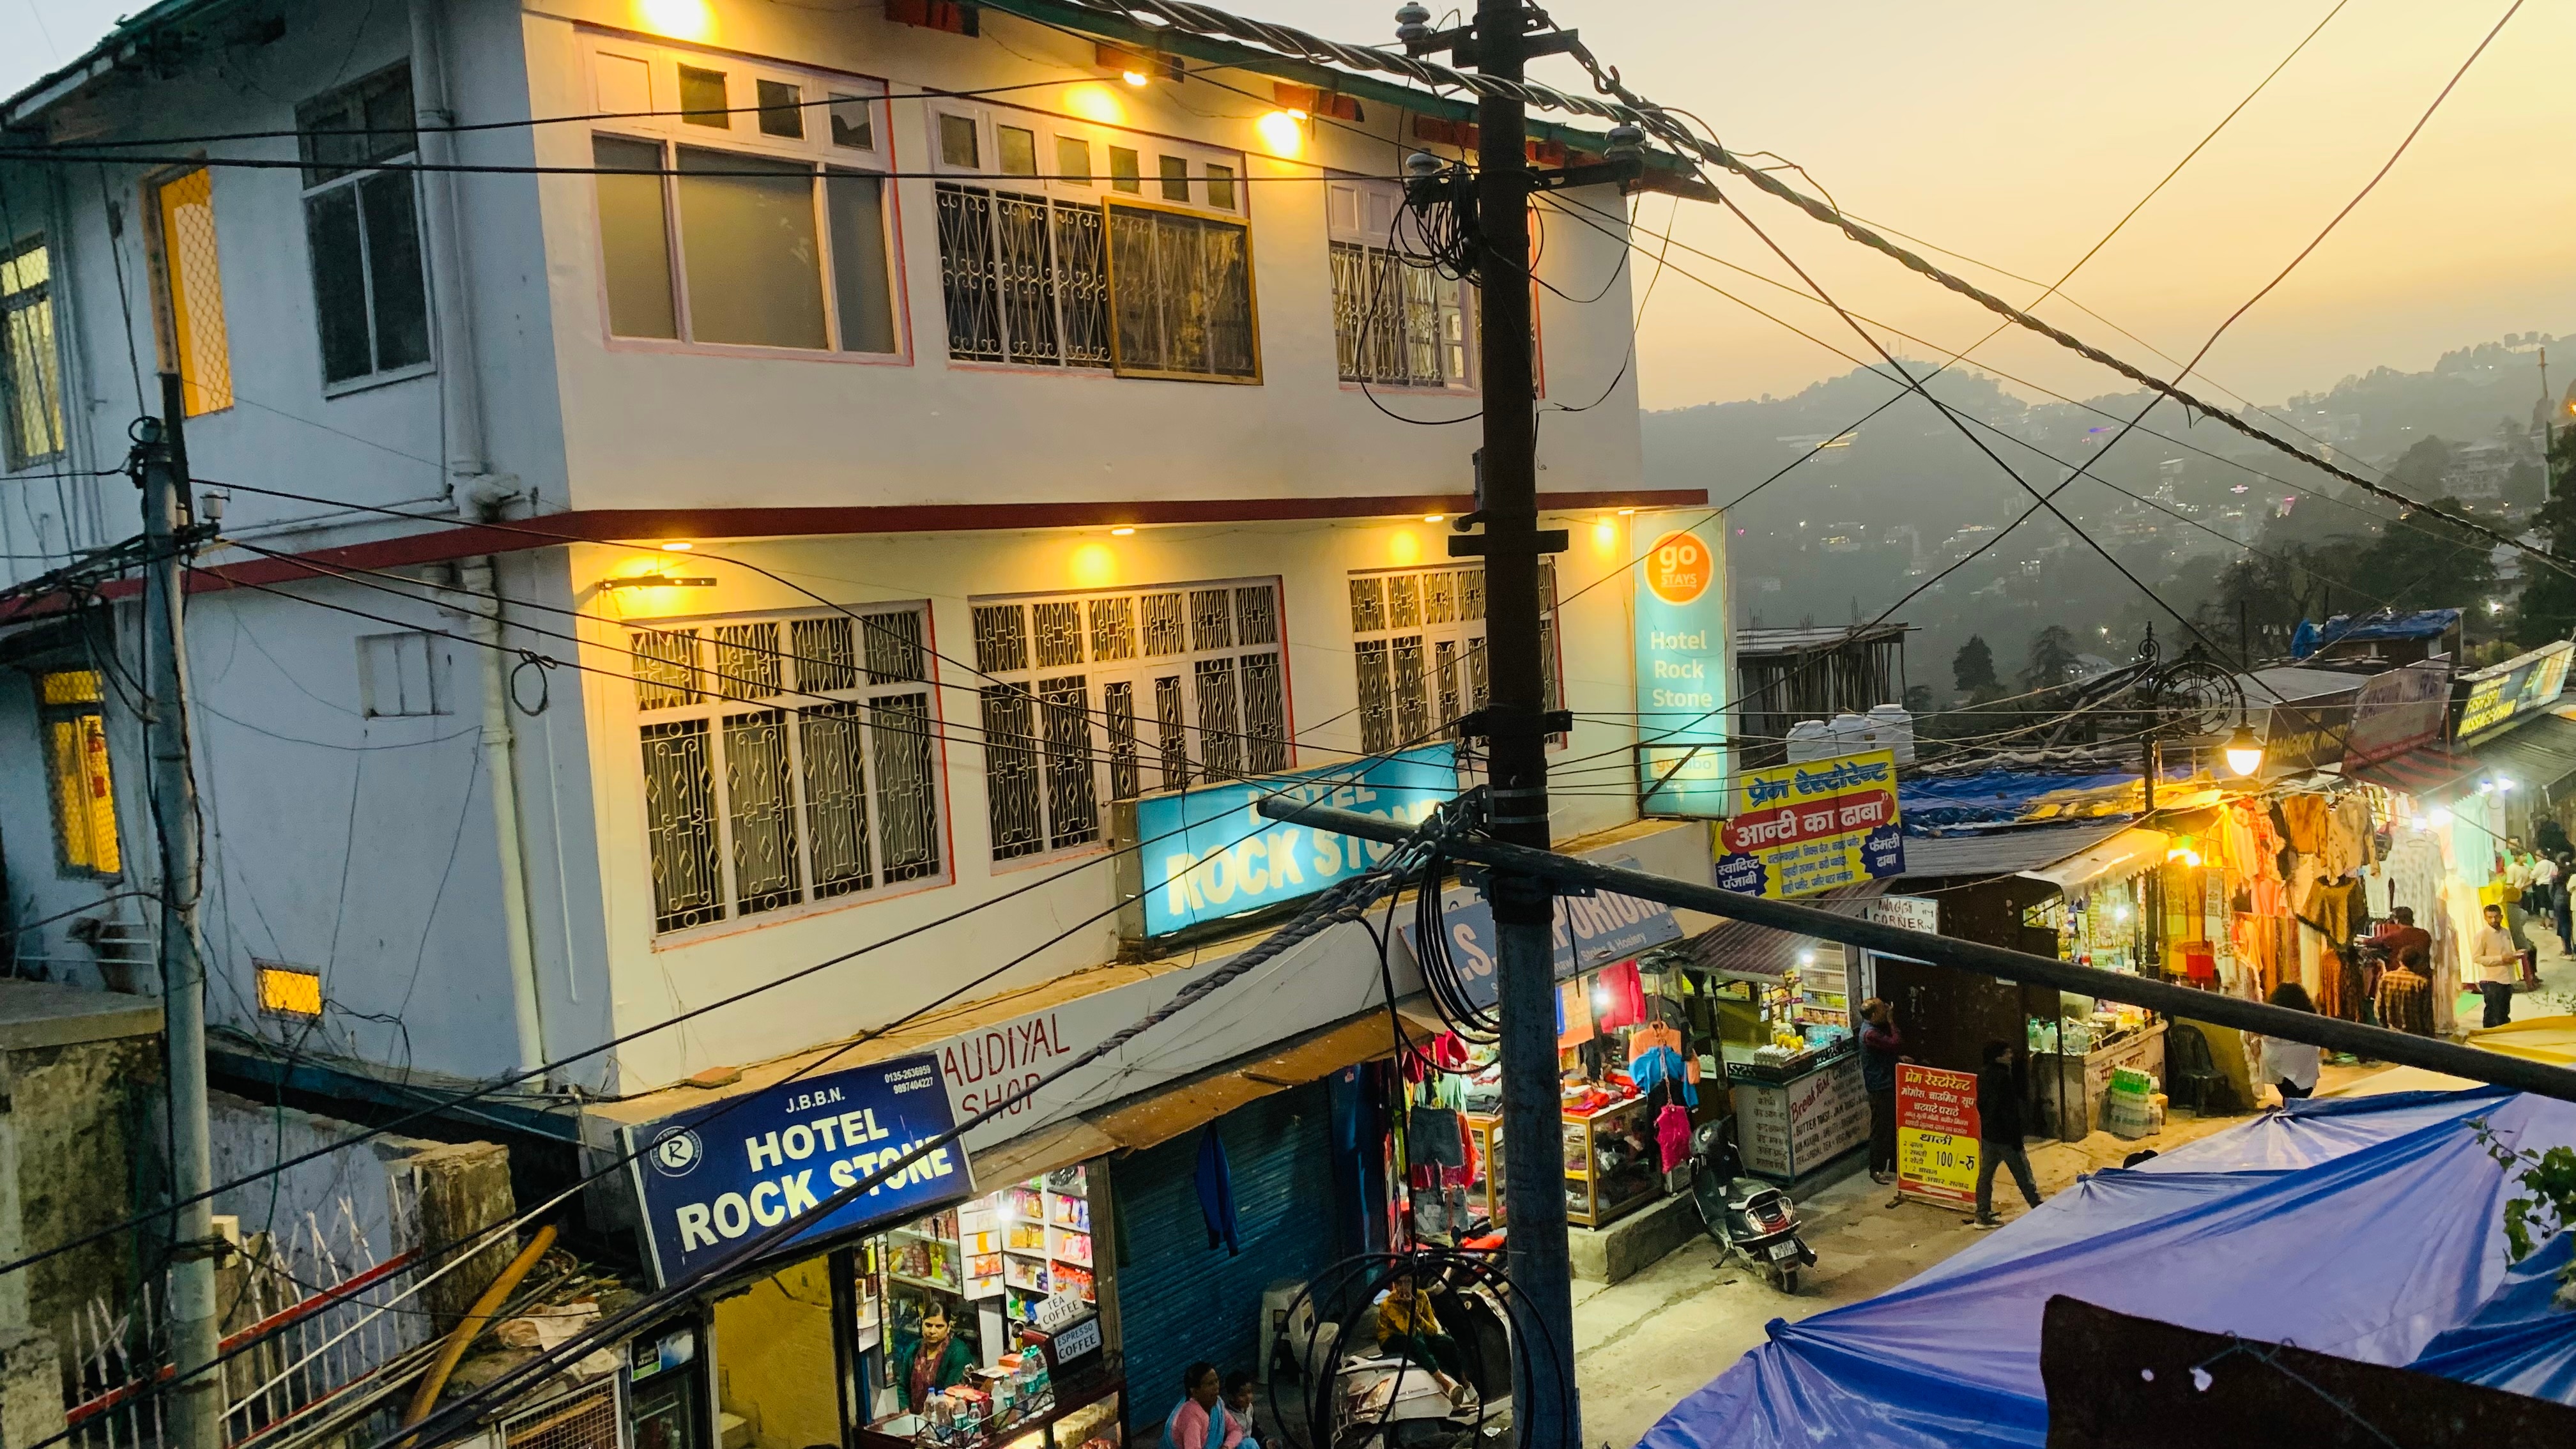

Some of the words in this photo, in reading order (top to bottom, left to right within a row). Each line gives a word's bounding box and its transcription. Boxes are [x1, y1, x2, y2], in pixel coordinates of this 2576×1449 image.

[1659, 544, 1698, 574] go
[1661, 573, 1697, 585] STAYS
[1650, 629, 1707, 650] Hotel
[1655, 659, 1705, 678] Rock
[1652, 688, 1712, 707] Stone
[1747, 778, 1790, 808] प्रेम
[1803, 809, 1835, 832] का
[1165, 829, 1303, 916] ROCK
[1718, 857, 1759, 875] स्वादिष्ट
[1722, 870, 1756, 889] पंजाबी
[884, 1064, 931, 1084] 0135-2636959
[1905, 1068, 1922, 1084] प्रेम
[893, 1077, 933, 1094] 9897404227
[786, 1087, 846, 1114] J.B.B.N.
[962, 1073, 1041, 1124] SHOP
[1962, 1096, 1974, 1108] सूप
[746, 1108, 889, 1172] HOTEL
[1920, 1134, 1953, 1146] थाली
[675, 1169, 820, 1252] ROCK
[829, 1135, 953, 1202] STONE
[1043, 1300, 1079, 1324] COFFEE
[1048, 1296, 1065, 1310] TEA
[1057, 1323, 1093, 1347] ESPRESSO
[1059, 1333, 1096, 1360] COFFEE
